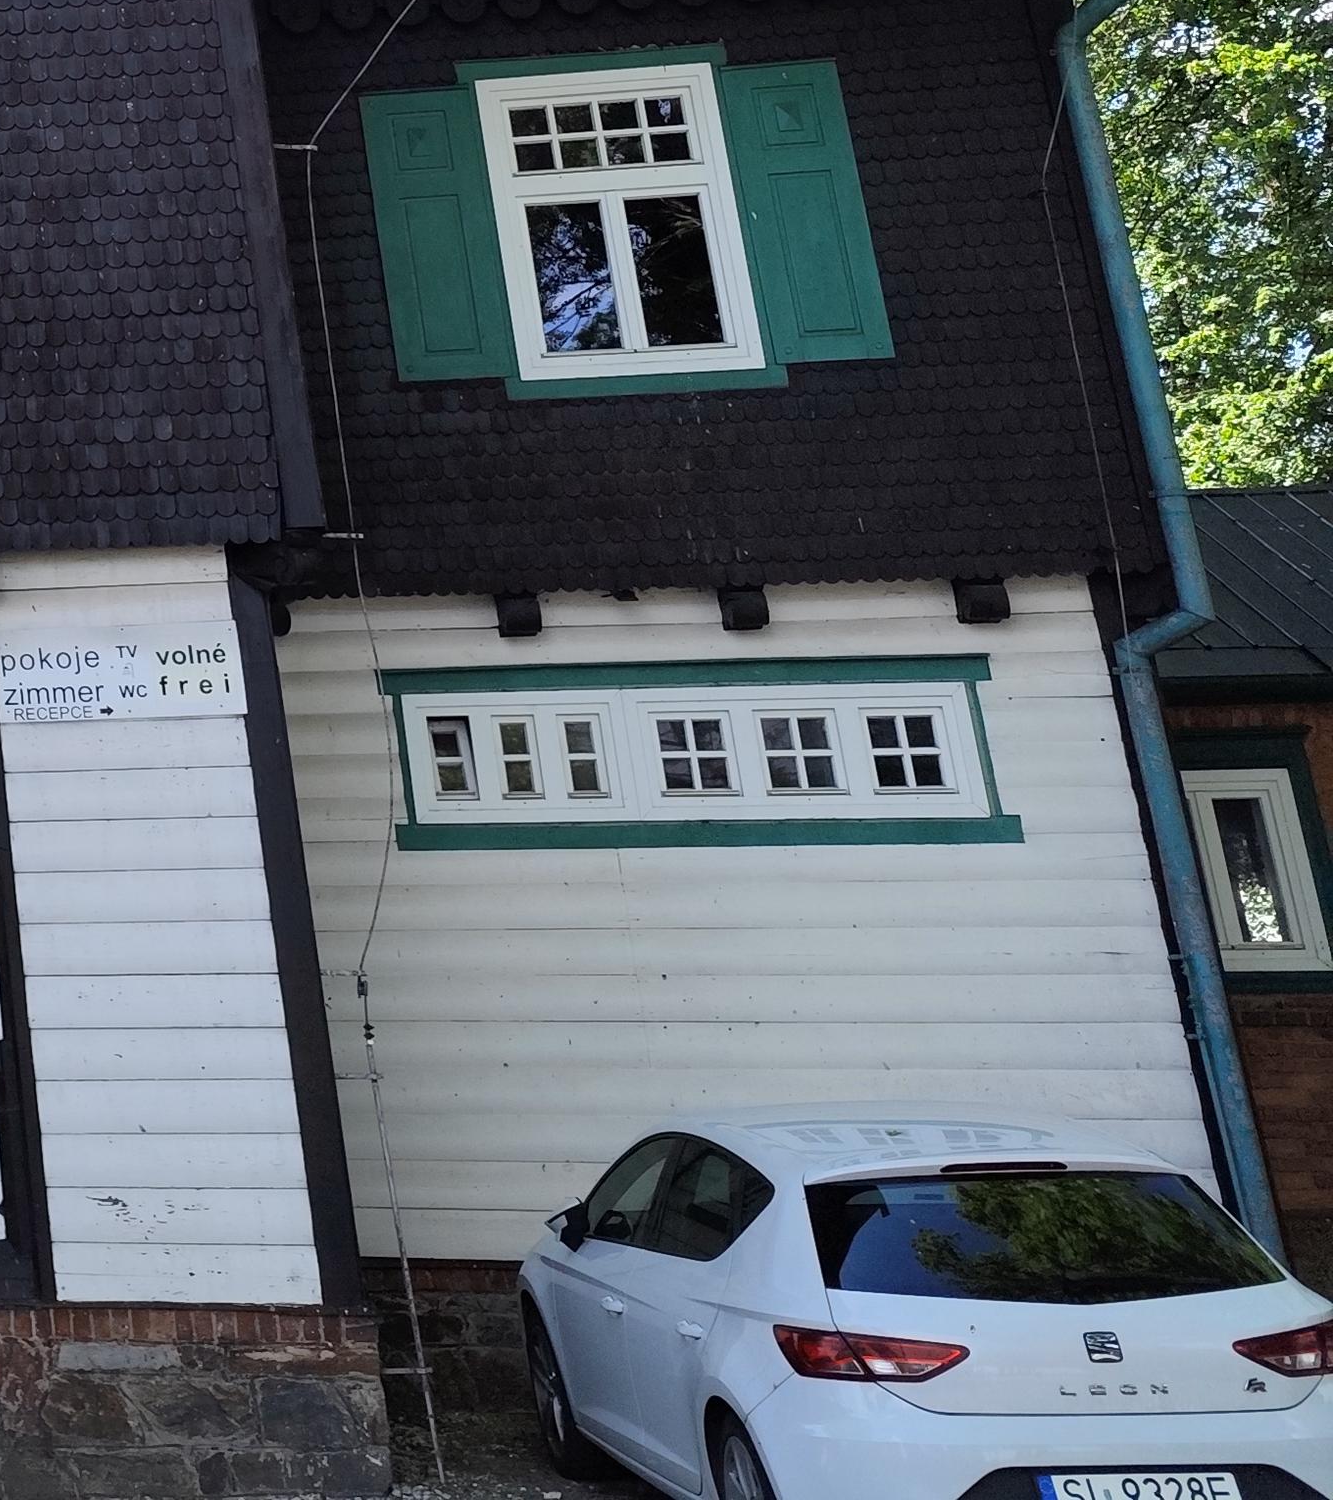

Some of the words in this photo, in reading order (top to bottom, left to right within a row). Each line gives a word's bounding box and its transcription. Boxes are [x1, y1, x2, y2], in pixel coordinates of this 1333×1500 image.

[0, 645, 100, 676] pokoje
[115, 645, 138, 659] TV
[155, 643, 227, 666] volné
[3, 682, 104, 706] zimmer
[159, 673, 230, 696] frei
[13, 705, 93, 721] RECEPCE
[1059, 1383, 1169, 1397] LEON
